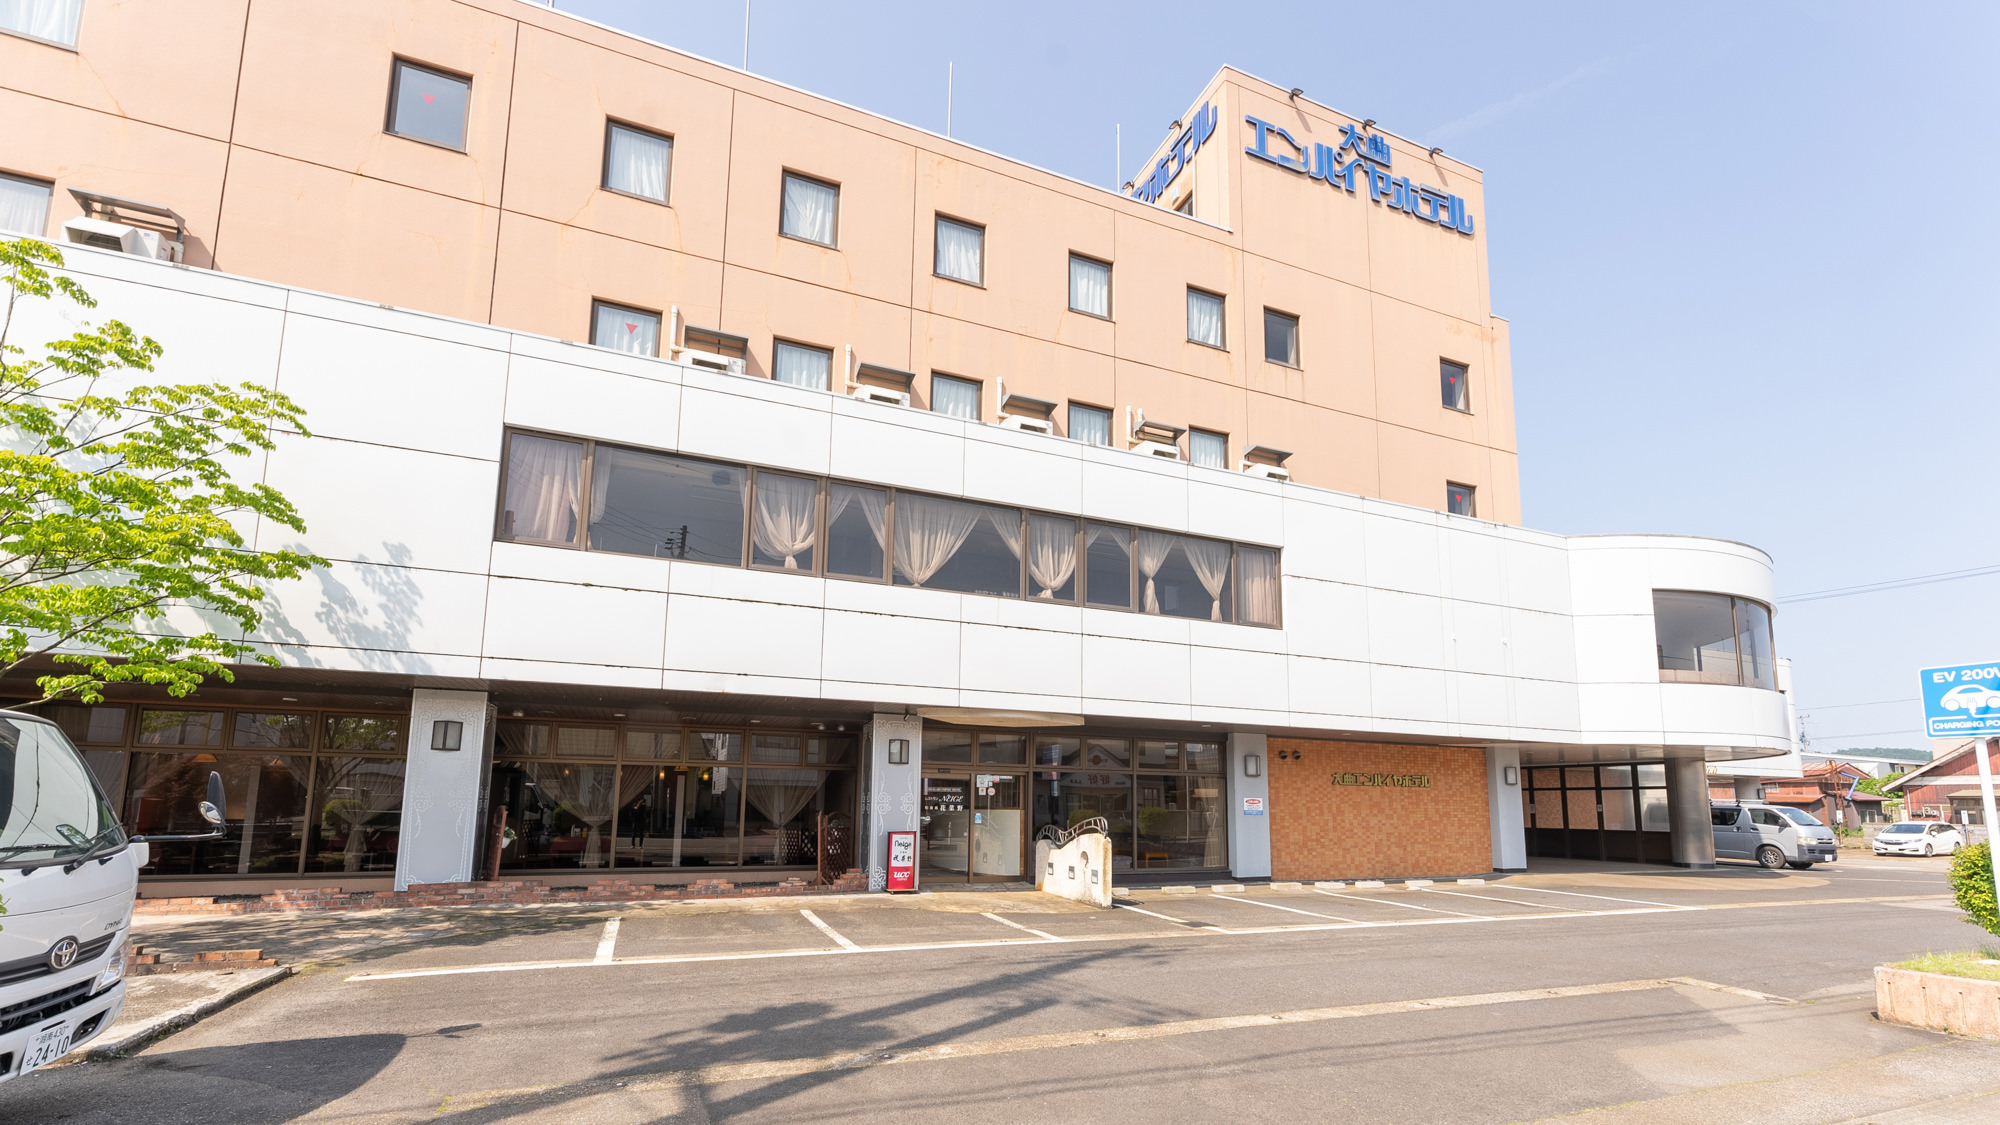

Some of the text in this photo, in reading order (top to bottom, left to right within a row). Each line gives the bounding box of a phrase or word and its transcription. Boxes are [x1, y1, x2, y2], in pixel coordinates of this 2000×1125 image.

[1338, 123, 1391, 167] 大曲
[1245, 114, 1474, 235] エンパイヤホテル
[1933, 671, 1956, 683] EV
[1934, 721, 1984, 729] CHARGING
[32, 1035, 70, 1068] 24-10
